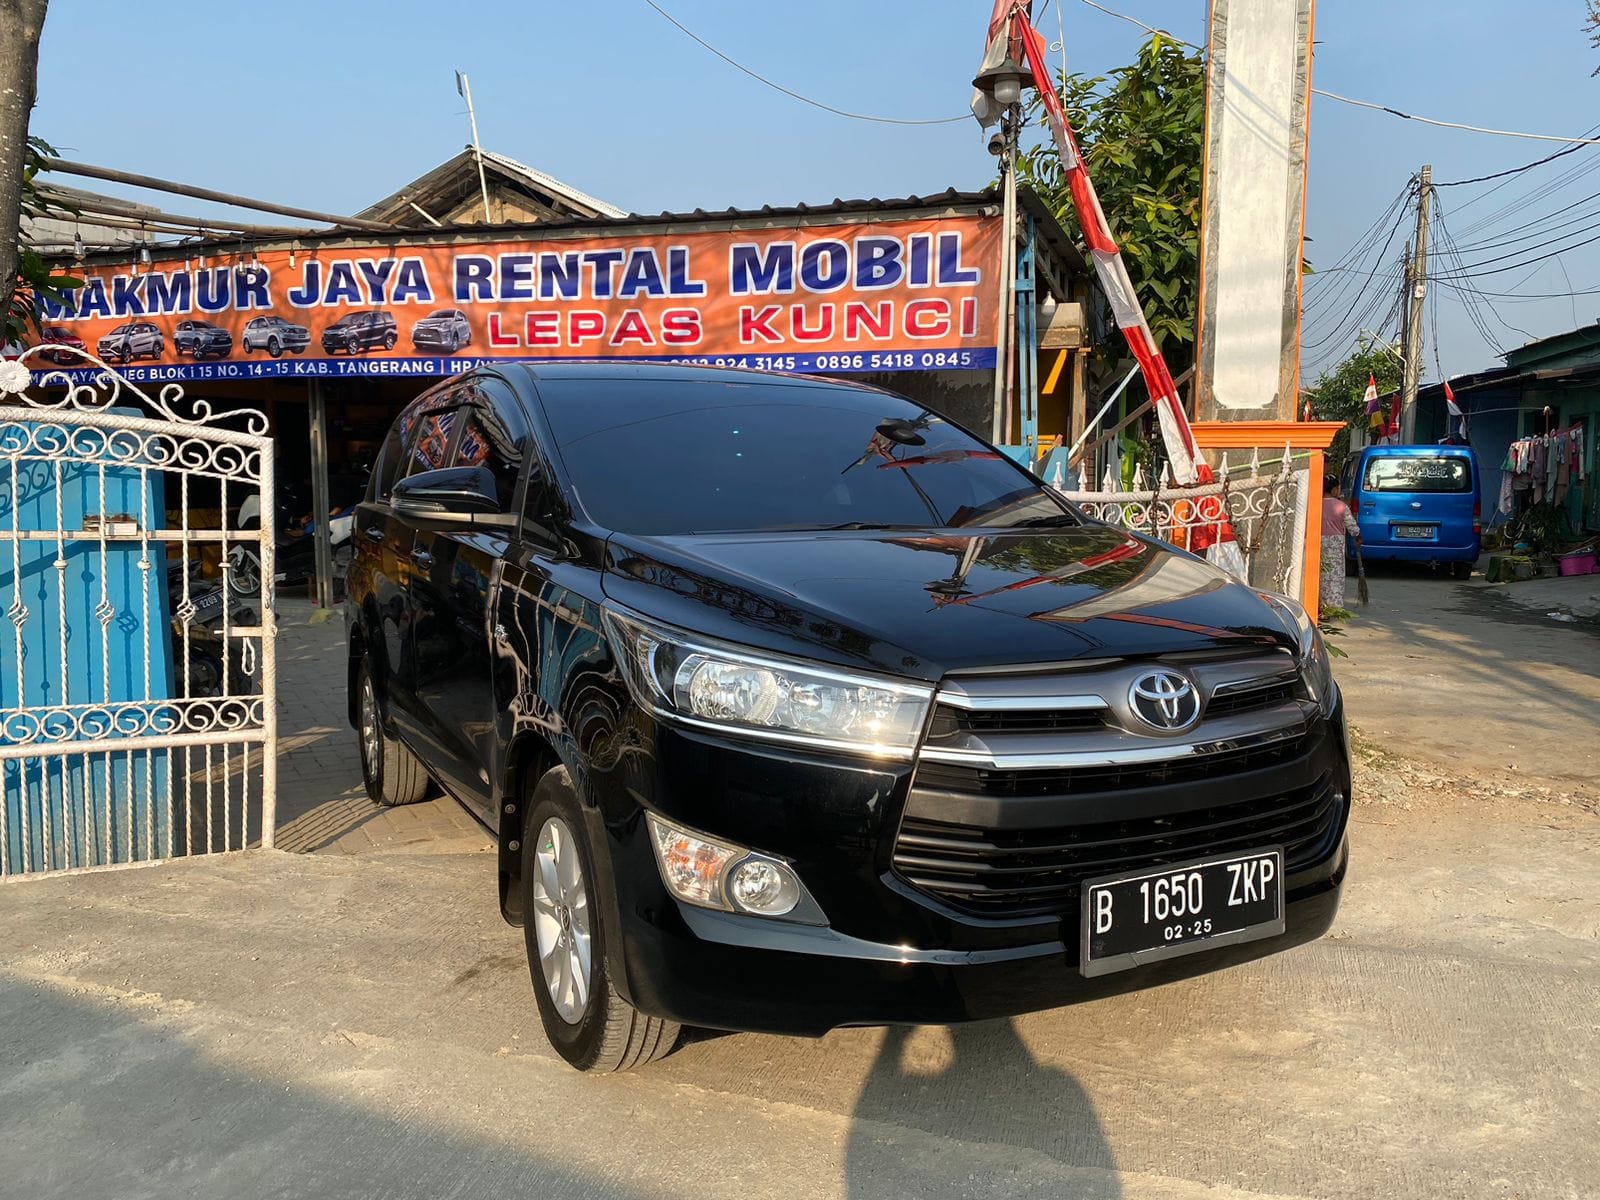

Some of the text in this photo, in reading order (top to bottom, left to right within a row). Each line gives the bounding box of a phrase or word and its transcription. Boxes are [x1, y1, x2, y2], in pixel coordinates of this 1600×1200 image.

[289, 256, 434, 306] JAYA
[454, 246, 707, 304] RENTAL
[730, 232, 981, 296] MOBIL
[489, 297, 977, 347] LEPAS KUNCI
[150, 367, 186, 380] BLOK
[199, 366, 213, 378] 15
[217, 365, 243, 377] NO.
[247, 364, 263, 376] 14
[276, 362, 289, 375] 15
[294, 362, 333, 375] KAB.
[337, 360, 435, 374] TANGERANG
[755, 356, 796, 370] 3145
[816, 355, 863, 369] 0896
[870, 353, 914, 368] 5418
[921, 352, 972, 367] 0845
[1096, 858, 1275, 934] B 1650 ZKP
